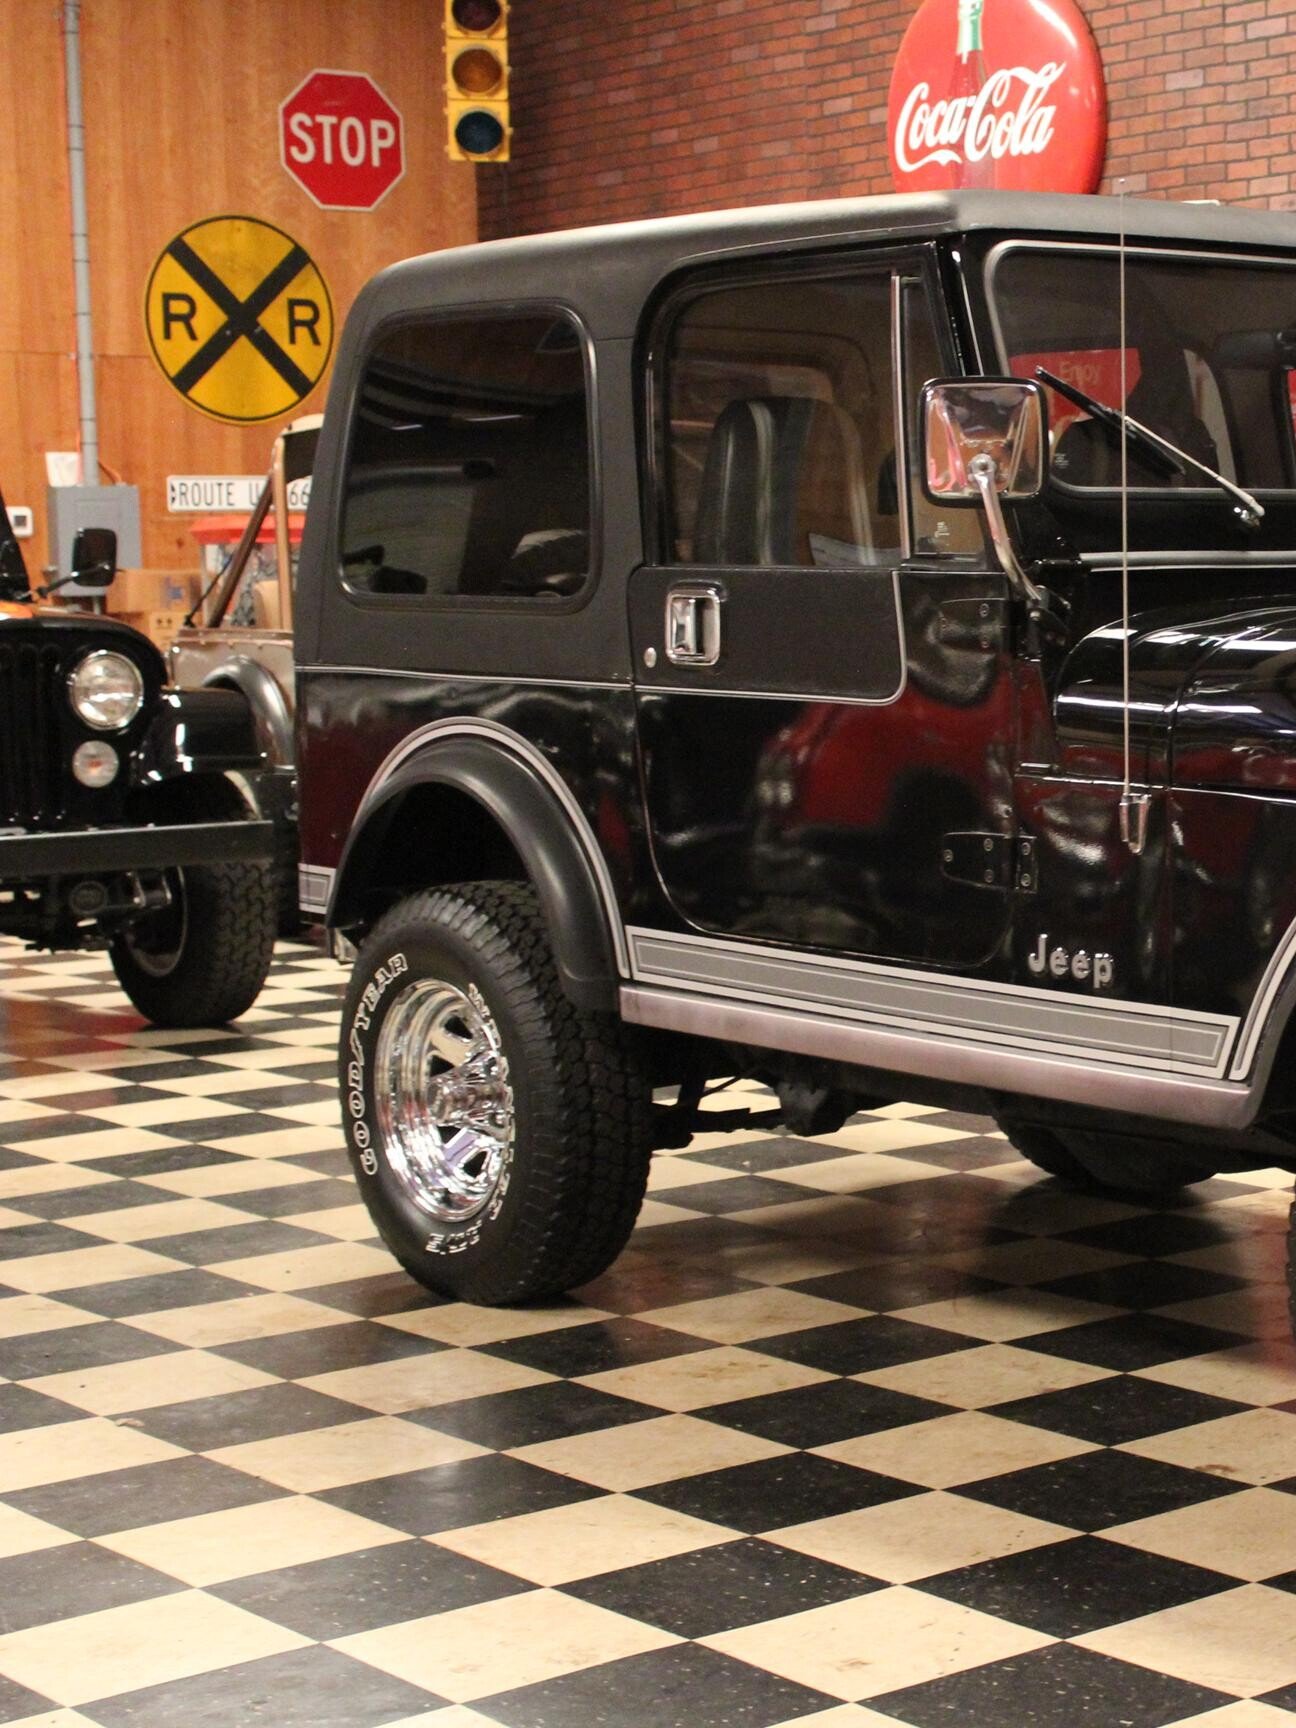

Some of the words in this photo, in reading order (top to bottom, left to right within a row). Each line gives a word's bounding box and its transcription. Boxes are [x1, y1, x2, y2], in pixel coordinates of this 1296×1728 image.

[289, 112, 395, 168] STOP
[895, 61, 1066, 173] Coca-Cola
[163, 292, 198, 341] R
[287, 299, 321, 346] R
[178, 482, 235, 507] ROUTE
[289, 484, 309, 506] 66
[1028, 933, 1113, 989] Jeep
